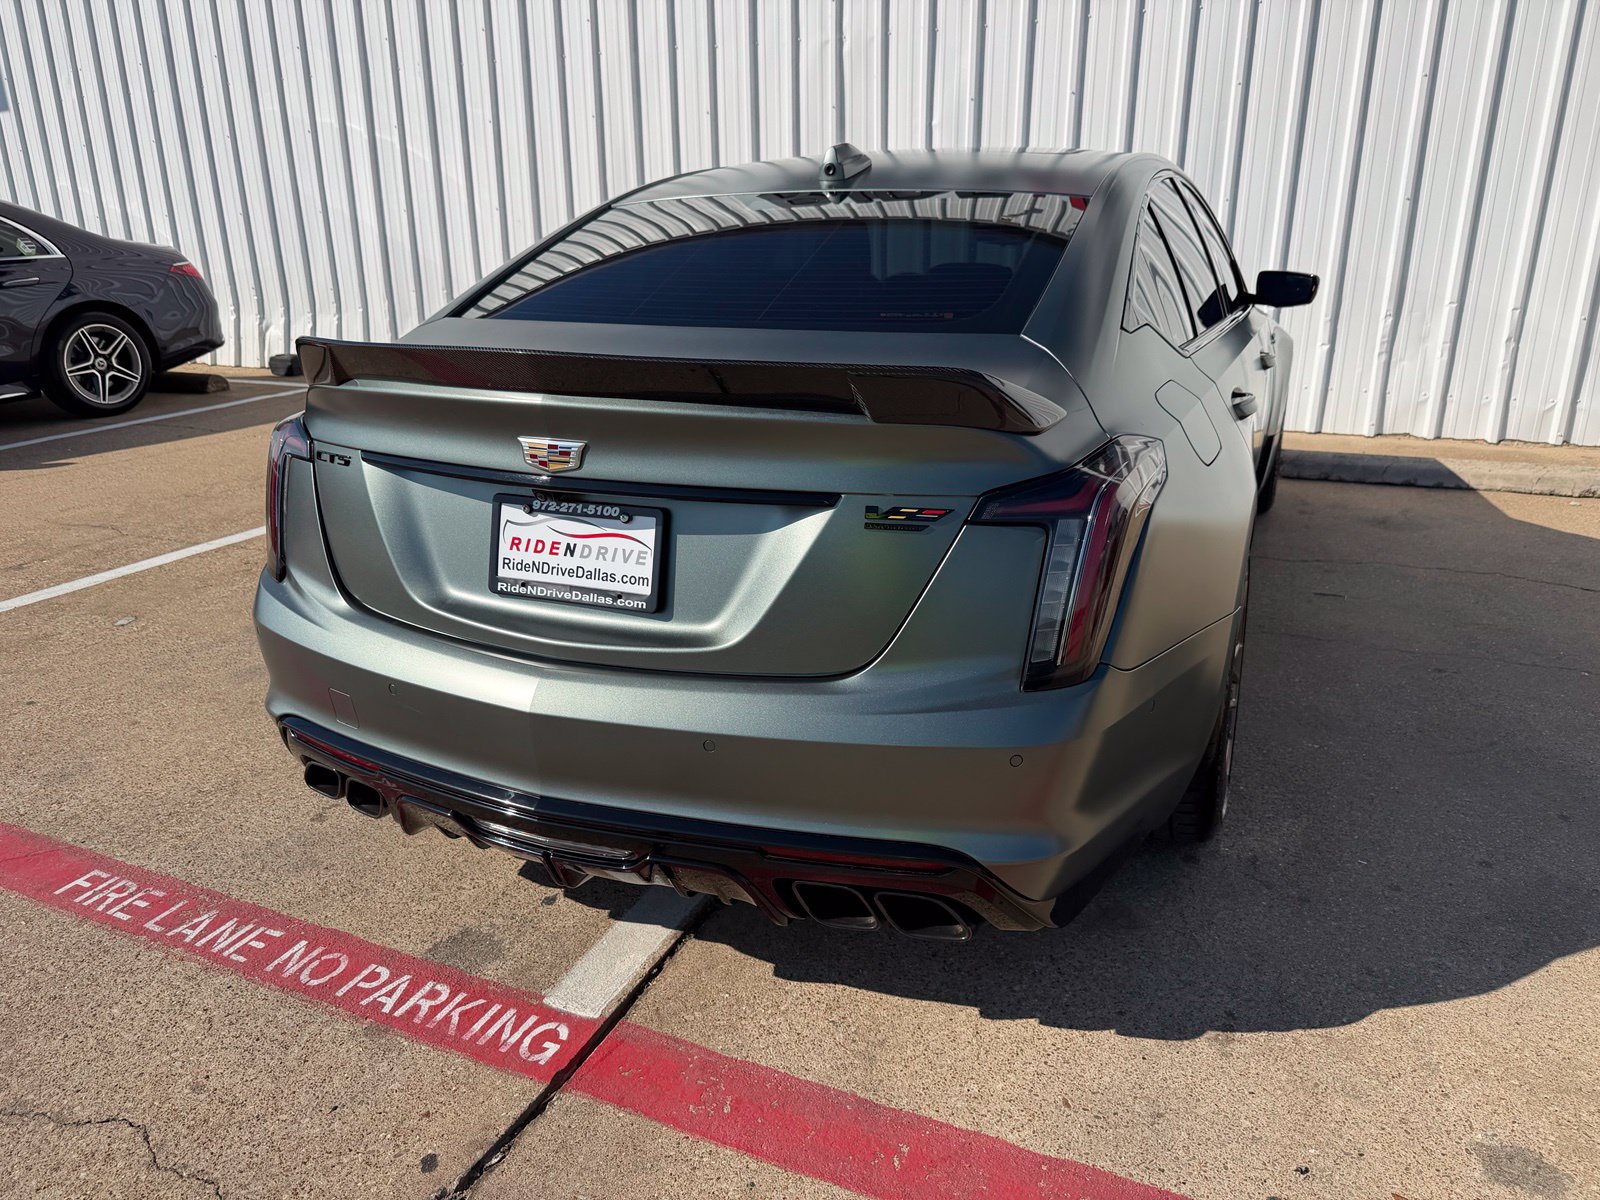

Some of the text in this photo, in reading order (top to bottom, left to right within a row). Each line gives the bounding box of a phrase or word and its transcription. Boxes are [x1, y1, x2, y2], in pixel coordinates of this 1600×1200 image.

[532, 500, 620, 517] 972-271-5100
[502, 557, 650, 588] RideNDriveDallas.com
[497, 582, 647, 609] RideNDriveDallas.com
[53, 869, 570, 1066] FIRE LANE NO PARKING
